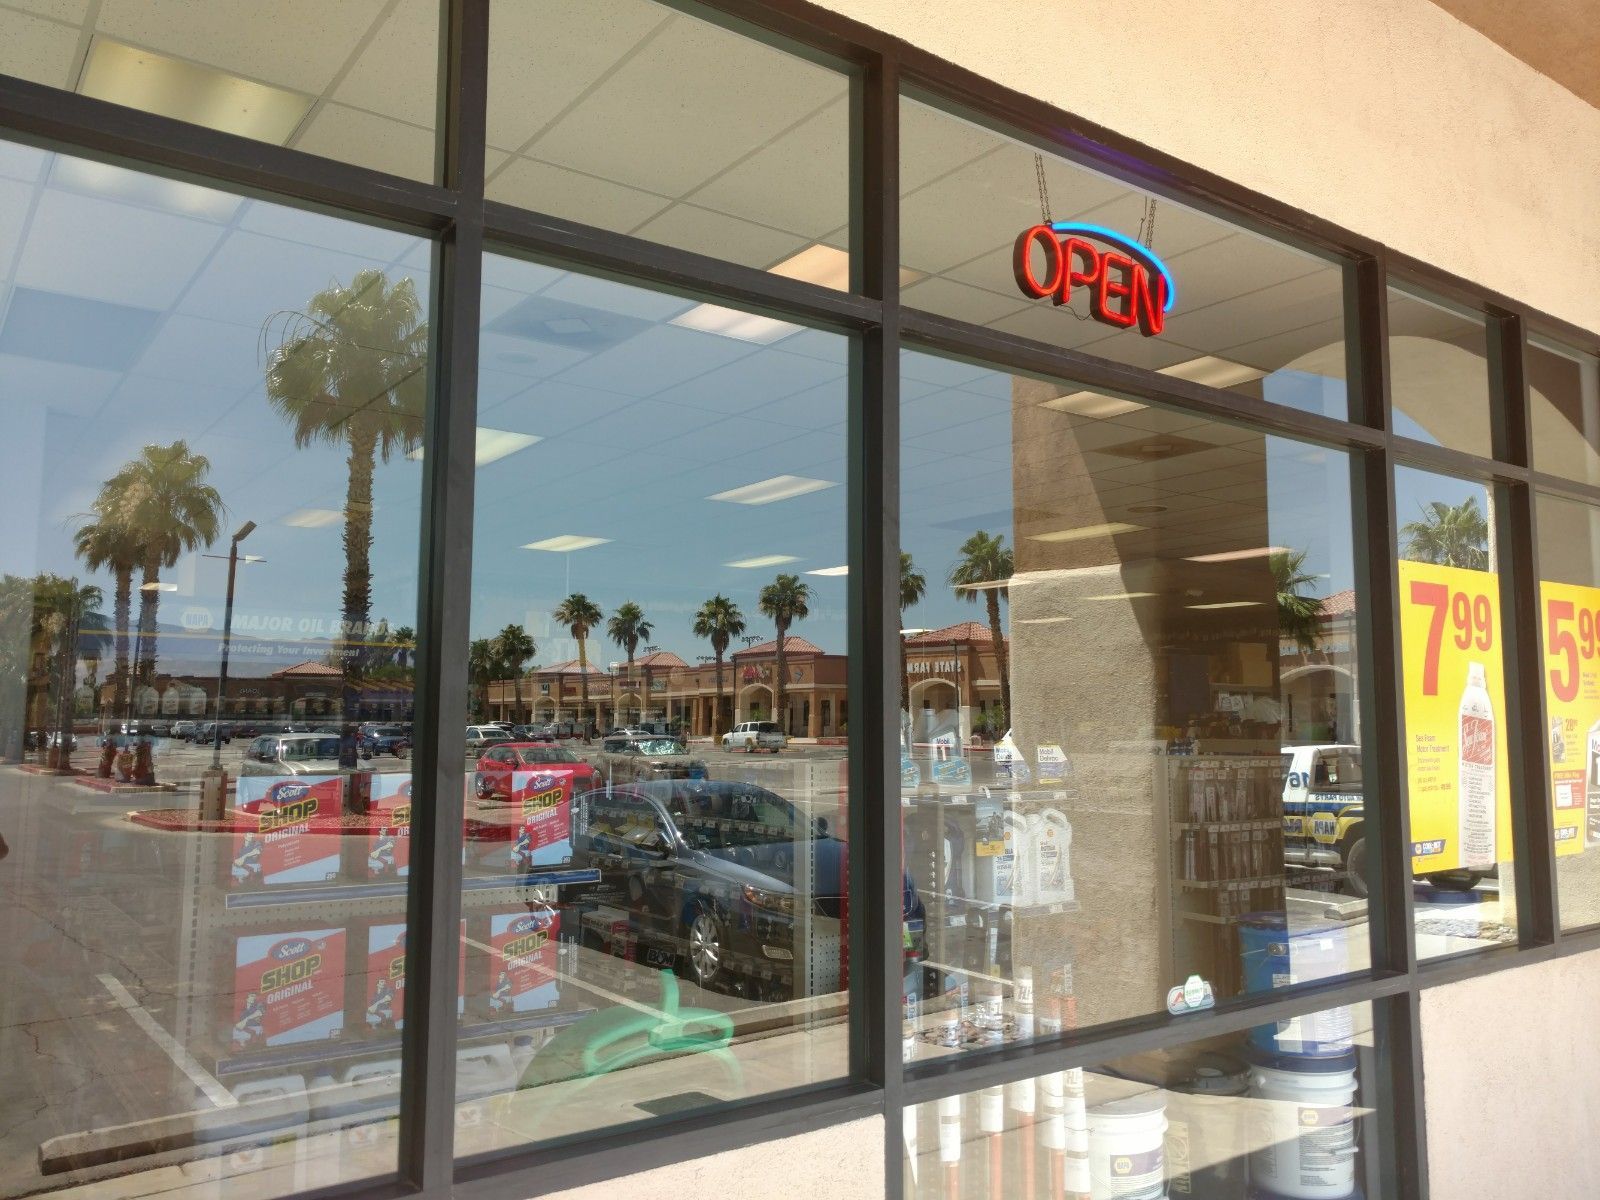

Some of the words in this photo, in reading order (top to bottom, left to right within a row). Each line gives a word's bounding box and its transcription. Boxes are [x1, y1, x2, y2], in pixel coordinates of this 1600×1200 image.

[1014, 223, 1166, 337] OPEN
[231, 613, 293, 632] MAJOR
[298, 617, 324, 633] OIL
[217, 642, 273, 656] Protecting
[277, 645, 300, 655] Your
[276, 786, 302, 800] Scott
[533, 776, 553, 790] Scott
[522, 787, 563, 817] SHOP
[258, 797, 319, 834] SHOP
[526, 806, 558, 825] ORIGINAL
[264, 822, 311, 843] ORIGINAL
[514, 919, 538, 933] Scott
[279, 942, 305, 958] Scott
[503, 930, 549, 962] SHOP
[508, 950, 543, 971] ORIGINAL
[260, 953, 322, 994] SHOP
[267, 979, 314, 1004] ORIGINAL
